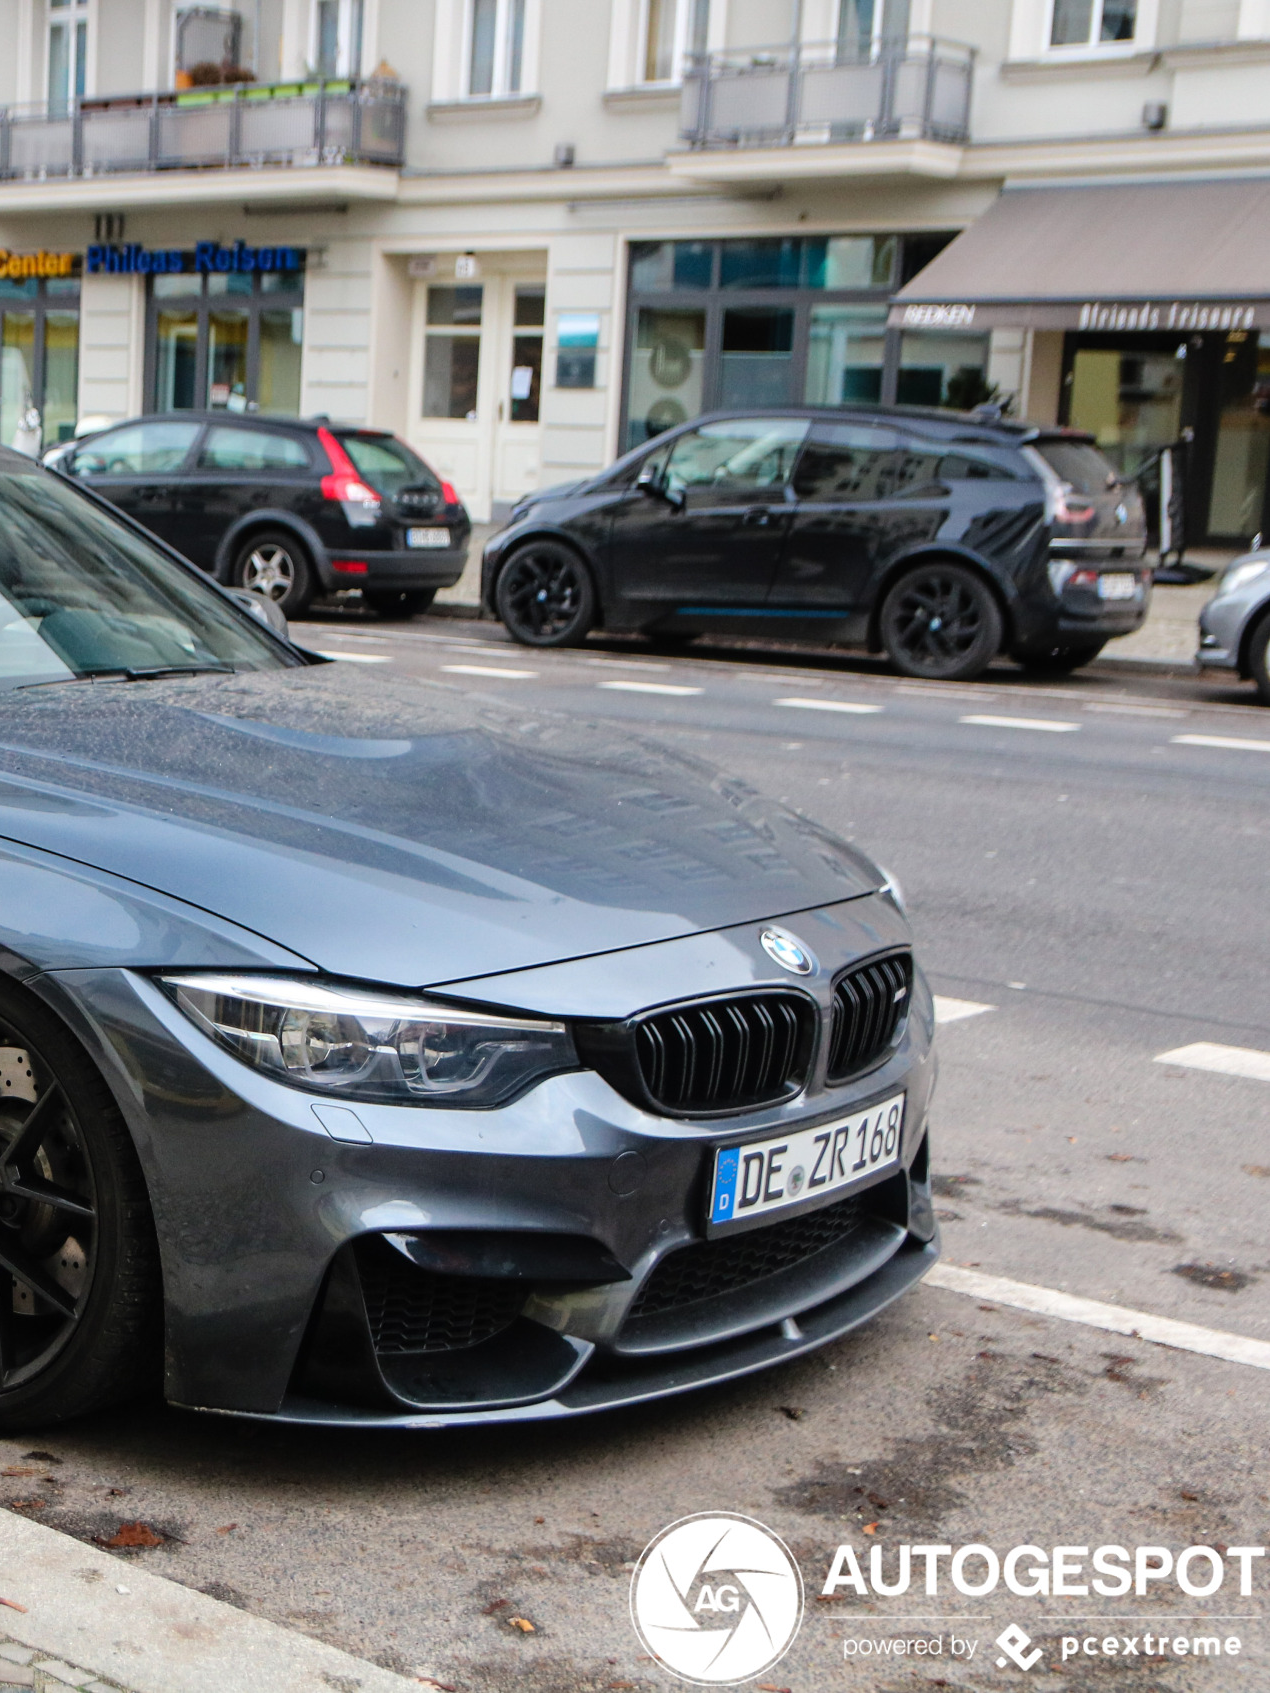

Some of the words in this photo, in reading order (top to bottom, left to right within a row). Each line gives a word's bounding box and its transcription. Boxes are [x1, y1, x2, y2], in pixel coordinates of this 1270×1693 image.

[903, 303, 976, 325] REDKEN
[718, 1193, 730, 1211] D
[738, 1145, 789, 1209] DE
